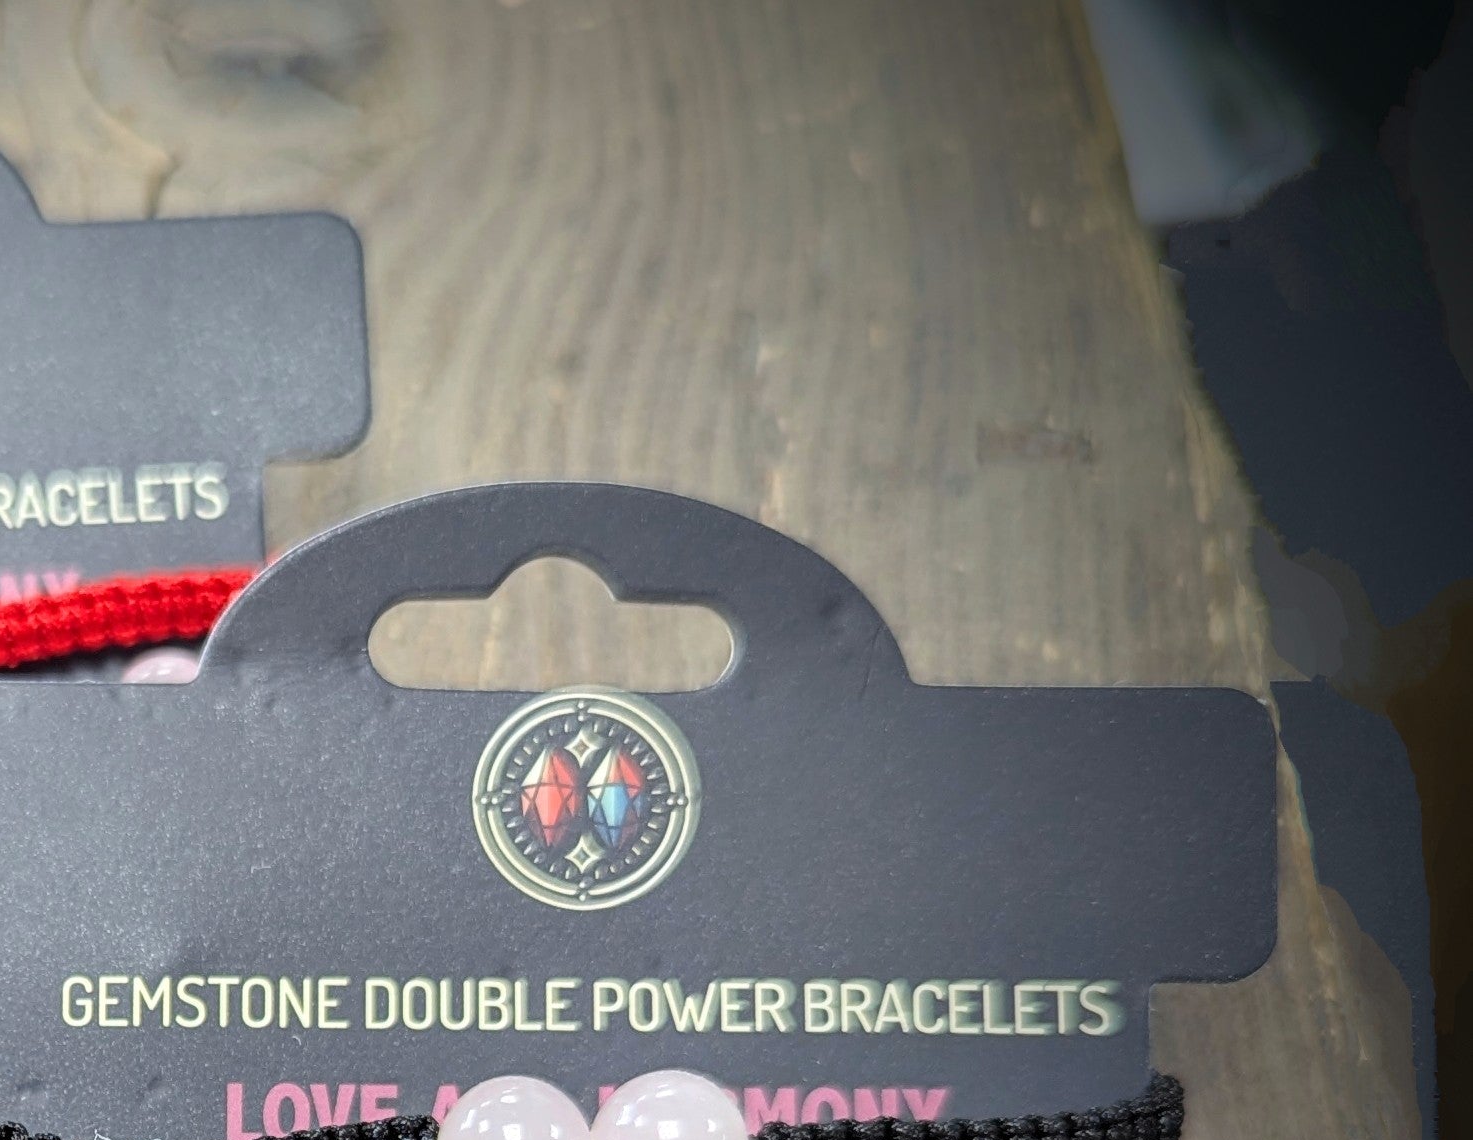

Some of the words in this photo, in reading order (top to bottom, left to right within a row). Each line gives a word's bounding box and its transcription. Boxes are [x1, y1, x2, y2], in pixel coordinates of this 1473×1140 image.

[61, 975, 350, 1029] GEMSTONE
[364, 977, 582, 1031] DOUBLE
[592, 979, 790, 1033] POWER
[803, 980, 1118, 1036] BRACELETS
